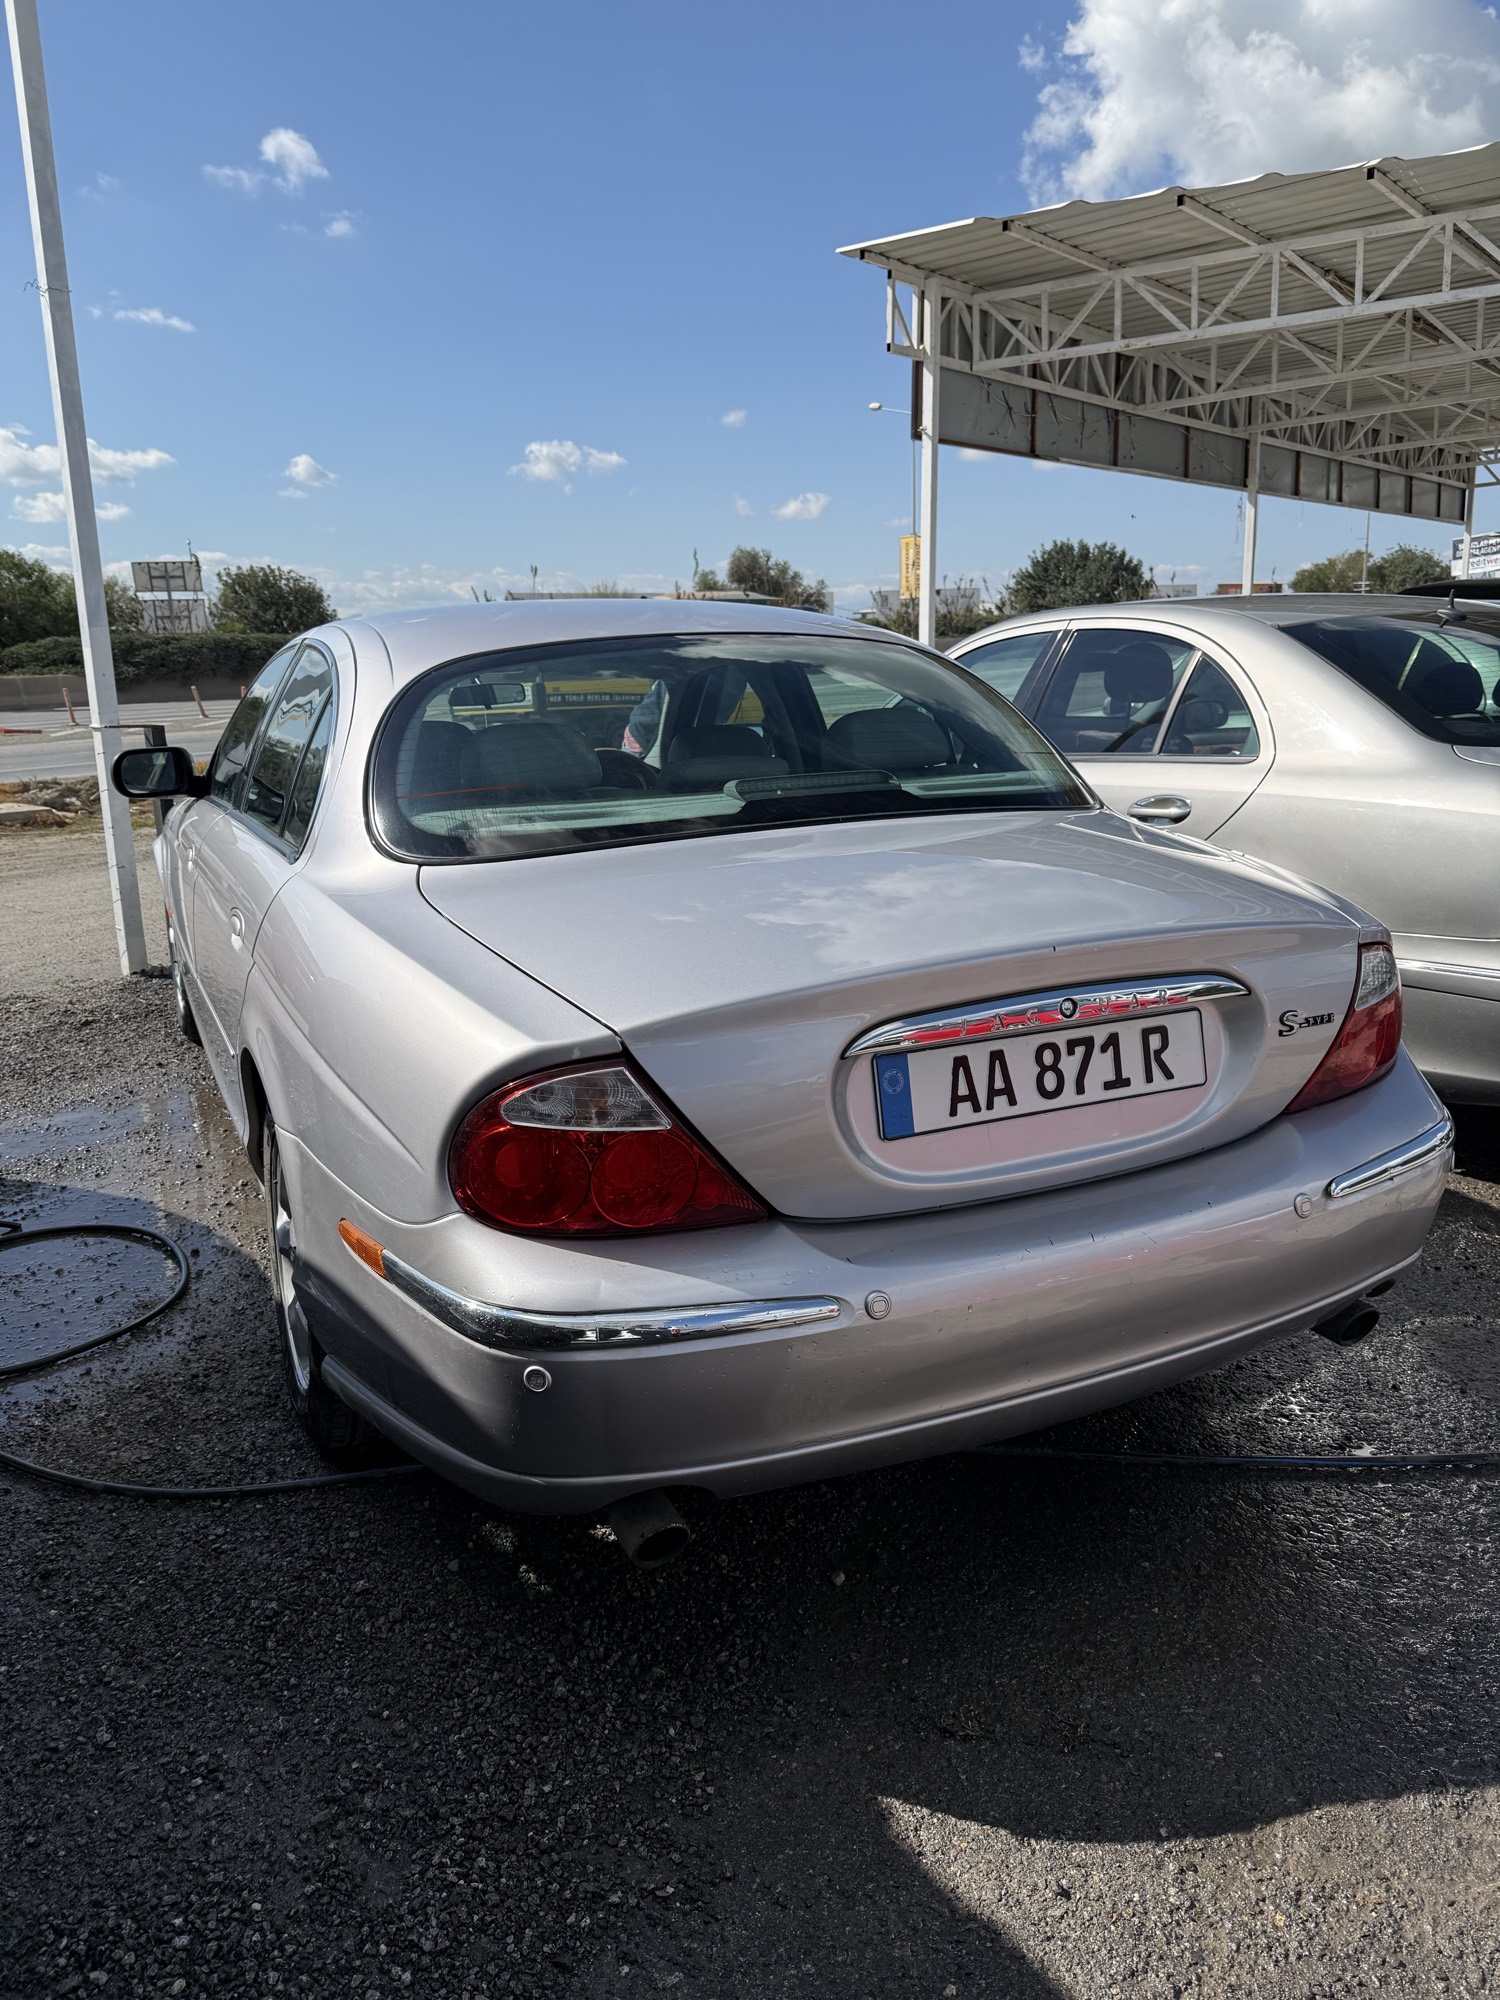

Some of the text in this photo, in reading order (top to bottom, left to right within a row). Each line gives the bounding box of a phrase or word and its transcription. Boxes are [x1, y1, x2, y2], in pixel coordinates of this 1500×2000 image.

[960, 988, 1168, 1037] JAGUAR
[948, 1024, 1175, 1118] AA 871 R
